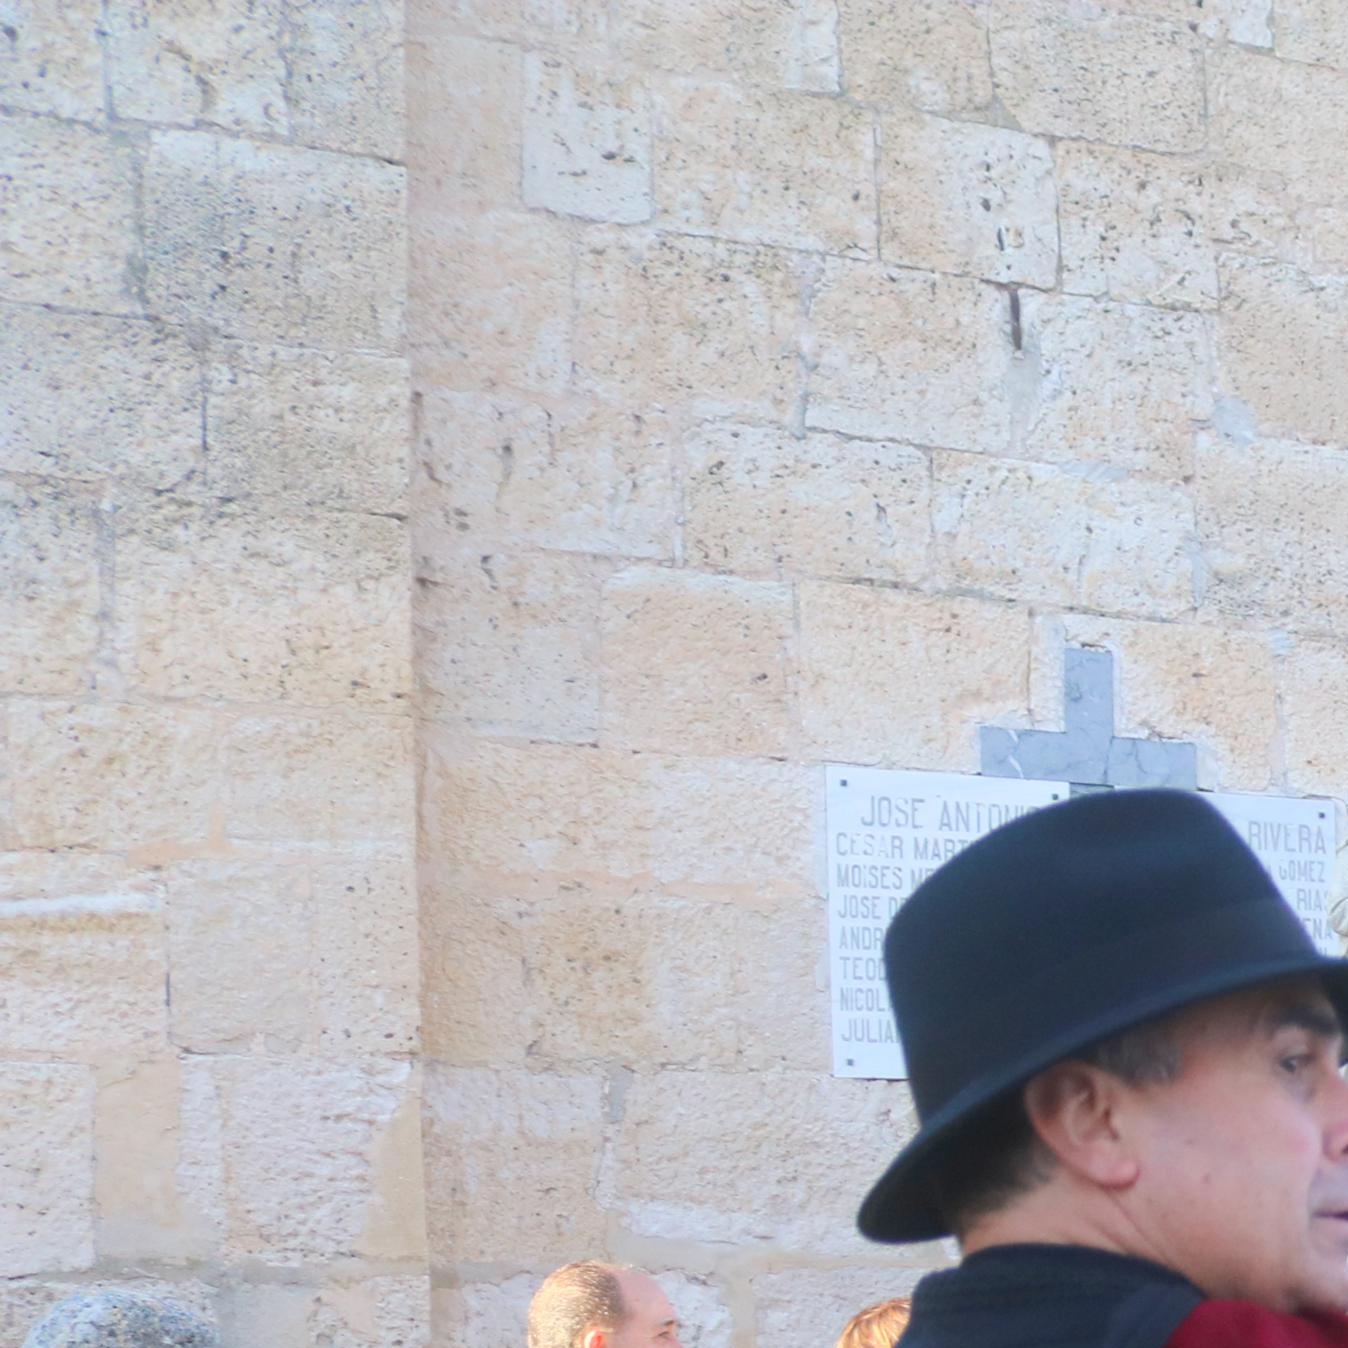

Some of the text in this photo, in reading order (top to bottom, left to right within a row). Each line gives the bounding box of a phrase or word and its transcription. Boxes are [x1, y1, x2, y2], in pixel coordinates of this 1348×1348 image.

[860, 794, 925, 829] JOSE
[836, 831, 904, 859] CESAR
[1247, 820, 1327, 855] RIVERA
[836, 863, 903, 890] MOISES
[838, 893, 882, 920] JOSE
[838, 925, 884, 951] ANDR
[840, 986, 893, 1013] NICOL
[841, 1017, 901, 1045] JULIA
